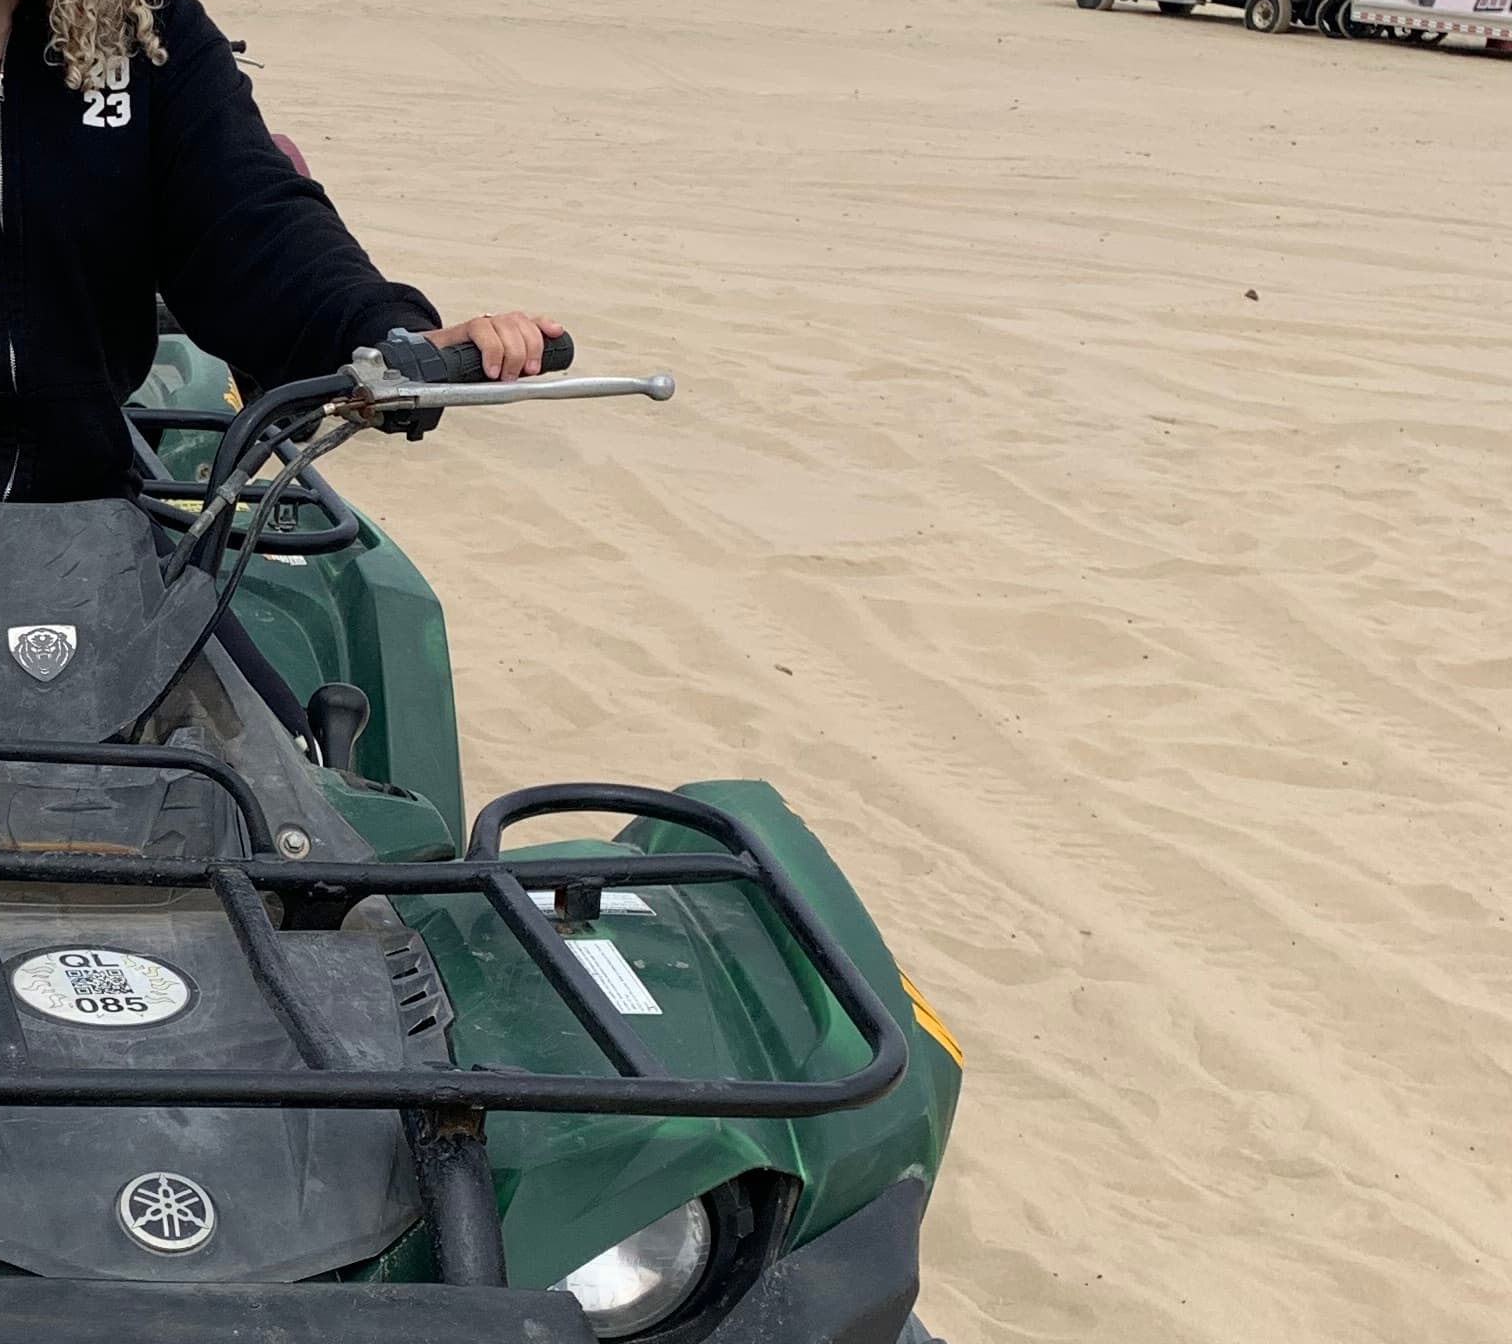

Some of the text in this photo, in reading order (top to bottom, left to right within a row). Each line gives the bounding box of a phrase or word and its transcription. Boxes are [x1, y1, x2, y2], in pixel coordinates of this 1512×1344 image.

[82, 90, 131, 128] 23
[59, 953, 119, 968] QL
[75, 997, 148, 1013] 085
